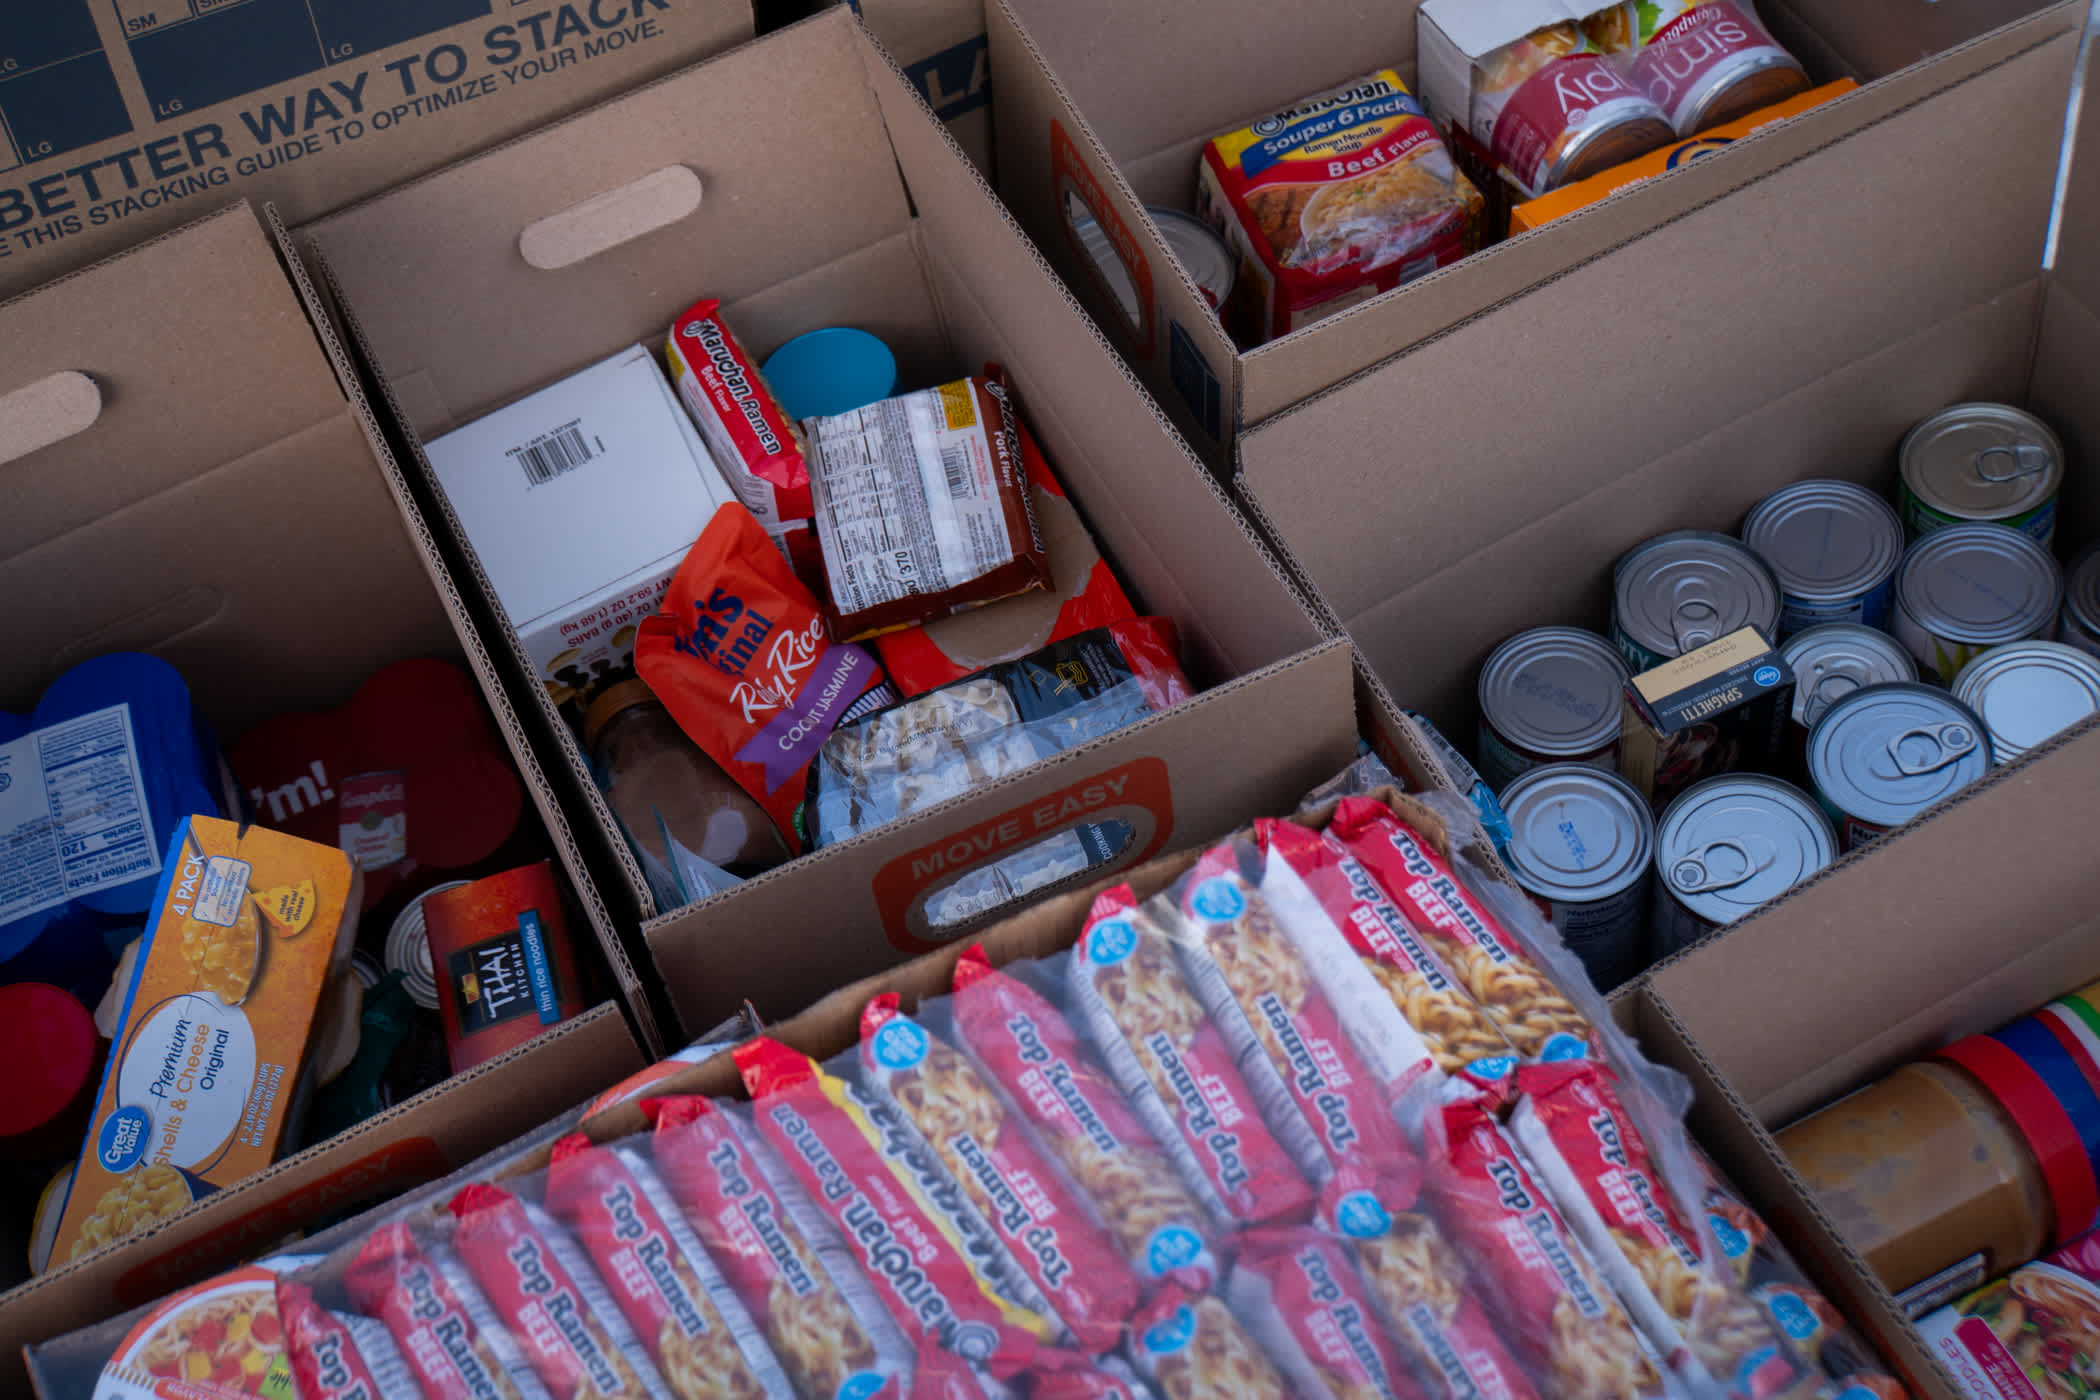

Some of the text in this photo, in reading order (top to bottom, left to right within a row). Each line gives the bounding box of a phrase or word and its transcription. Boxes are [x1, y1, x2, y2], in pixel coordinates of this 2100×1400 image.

[127, 14, 157, 31] SM
[329, 42, 353, 60] LG
[14, 215, 82, 249] THIS
[88, 167, 230, 225] STACKING
[236, 135, 323, 177] GUIDE
[326, 120, 365, 145] TO
[371, 73, 499, 131] OPTIMIZE
[502, 47, 577, 84] YOUR
[585, 19, 665, 60] MOVE.
[158, 99, 184, 116] LG
[1263, 98, 1409, 156] Souper 6 Pack
[0, 123, 231, 231] BETTER
[239, 72, 369, 145] WAY
[385, 43, 468, 98] TO
[26, 141, 53, 158] LG
[1303, 125, 1385, 155] Ramen Noodle
[1327, 128, 1432, 179] Beef Flavor
[1335, 141, 1363, 155] Soup
[699, 318, 754, 404] Maruchan
[741, 396, 782, 456] Ramen
[700, 364, 721, 391] Beef
[992, 429, 1011, 465] Pork
[893, 549, 913, 575] 370
[610, 599, 628, 613] OZ
[566, 625, 602, 648] BARS
[766, 614, 826, 686] Rice
[820, 650, 861, 719] JASMINE
[1679, 686, 1745, 722] SPAGHETTI
[61, 840, 88, 858] 120
[911, 774, 1129, 880] MOVE EASY
[67, 856, 153, 889] Nutrition Facts
[171, 851, 206, 917] 4 PACK
[1390, 829, 1507, 963] Top Ramen
[293, 896, 305, 921] cheese
[1338, 857, 1381, 902] Top
[1375, 904, 1448, 991] Ramen
[1350, 904, 1399, 954] BEEF
[1405, 880, 1456, 929] BEEF
[478, 945, 516, 1019] THAI
[510, 942, 531, 999] KITCHEN
[525, 922, 553, 1013] thin rice noodles
[149, 1018, 193, 1099] Premium
[199, 1028, 230, 1091] Original
[1008, 1013, 1119, 1155] Top Ramen
[1260, 994, 1357, 1152] Top Ramen
[1308, 1038, 1353, 1089] BEEF
[153, 1023, 210, 1165] Shells & Cheese
[1016, 1068, 1066, 1118] BEEF
[1148, 1033, 1249, 1192] Top Ramen
[1197, 1074, 1244, 1126] BEEF
[104, 1114, 134, 1164] Great
[121, 1118, 144, 1156] Value
[771, 1103, 855, 1203] Ramen
[709, 1141, 814, 1295] Top Ramen
[952, 1133, 1072, 1291] Top Ramen
[1008, 1169, 1058, 1222] BEEF
[1597, 1169, 1642, 1224] BEEF
[718, 1203, 763, 1259] BEEF
[892, 1217, 938, 1263] Beef
[1487, 1159, 1602, 1317] Top Ramen
[1499, 1216, 1547, 1268] BEEF
[604, 1183, 707, 1335] Top Ramen
[610, 1245, 655, 1300] BEEF
[1296, 1246, 1342, 1302] Top
[402, 1265, 445, 1319] Top
[509, 1237, 620, 1393] Top Ramen
[405, 1326, 454, 1382] BEEF
[517, 1300, 567, 1358] BEEF
[313, 1332, 350, 1387] Top
[1938, 1336, 1994, 1400] OODLES
